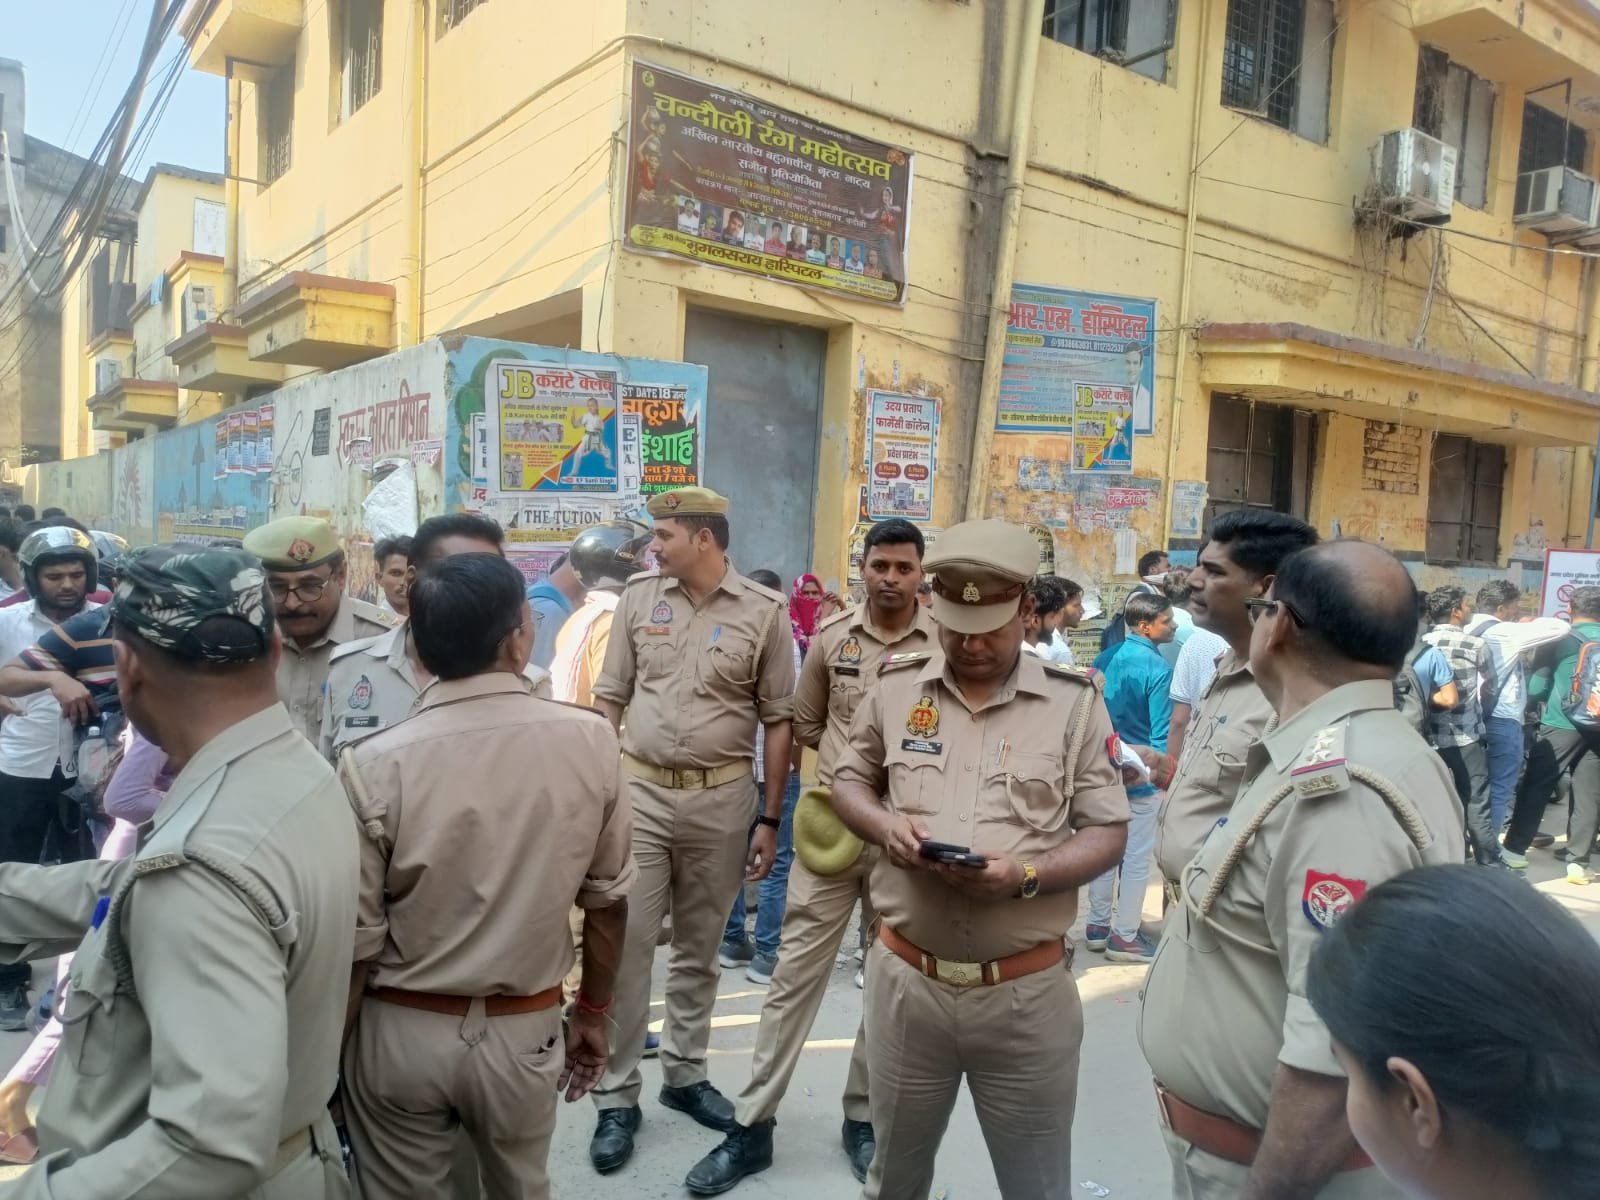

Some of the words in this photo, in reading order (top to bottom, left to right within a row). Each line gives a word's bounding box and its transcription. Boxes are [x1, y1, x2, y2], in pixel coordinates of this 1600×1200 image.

[653, 92, 754, 140] चन्दौली
[757, 119, 796, 153] रंग
[799, 140, 892, 181] महोत्सव
[681, 126, 718, 145] अखिल
[721, 138, 763, 158] भारतीय
[770, 167, 822, 190] प्रतियोगिता
[687, 239, 763, 267] मुगलसराय
[1080, 302, 1148, 341] हॉस्पिटल
[501, 369, 536, 399] JB
[535, 371, 575, 389] कराटे
[622, 387, 635, 397] ST
[636, 388, 658, 399] DATE
[659, 388, 671, 399] 18
[1076, 386, 1093, 407] JB
[884, 401, 902, 412] उदय
[903, 402, 922, 414] प्रताप
[905, 418, 930, 432] कॉलेज
[524, 510, 551, 524] THE
[553, 510, 602, 524] TUTION
